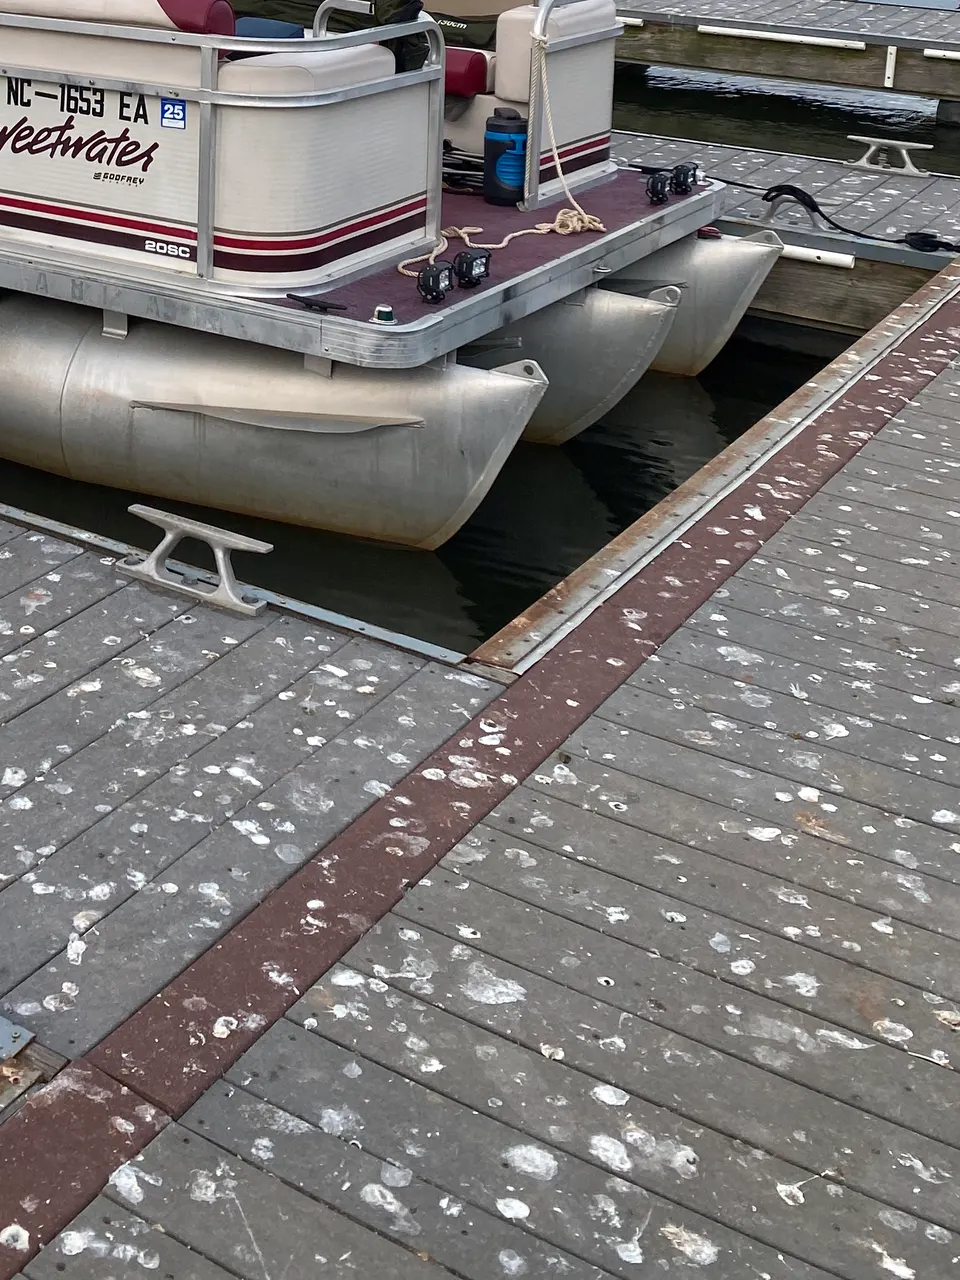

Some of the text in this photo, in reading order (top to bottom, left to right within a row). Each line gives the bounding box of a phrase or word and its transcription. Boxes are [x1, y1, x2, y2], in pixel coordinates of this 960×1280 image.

[119, 91, 149, 125] EA
[163, 104, 184, 119] 25
[103, 172, 145, 185] GODFREY
[144, 240, 191, 258] 20SC
